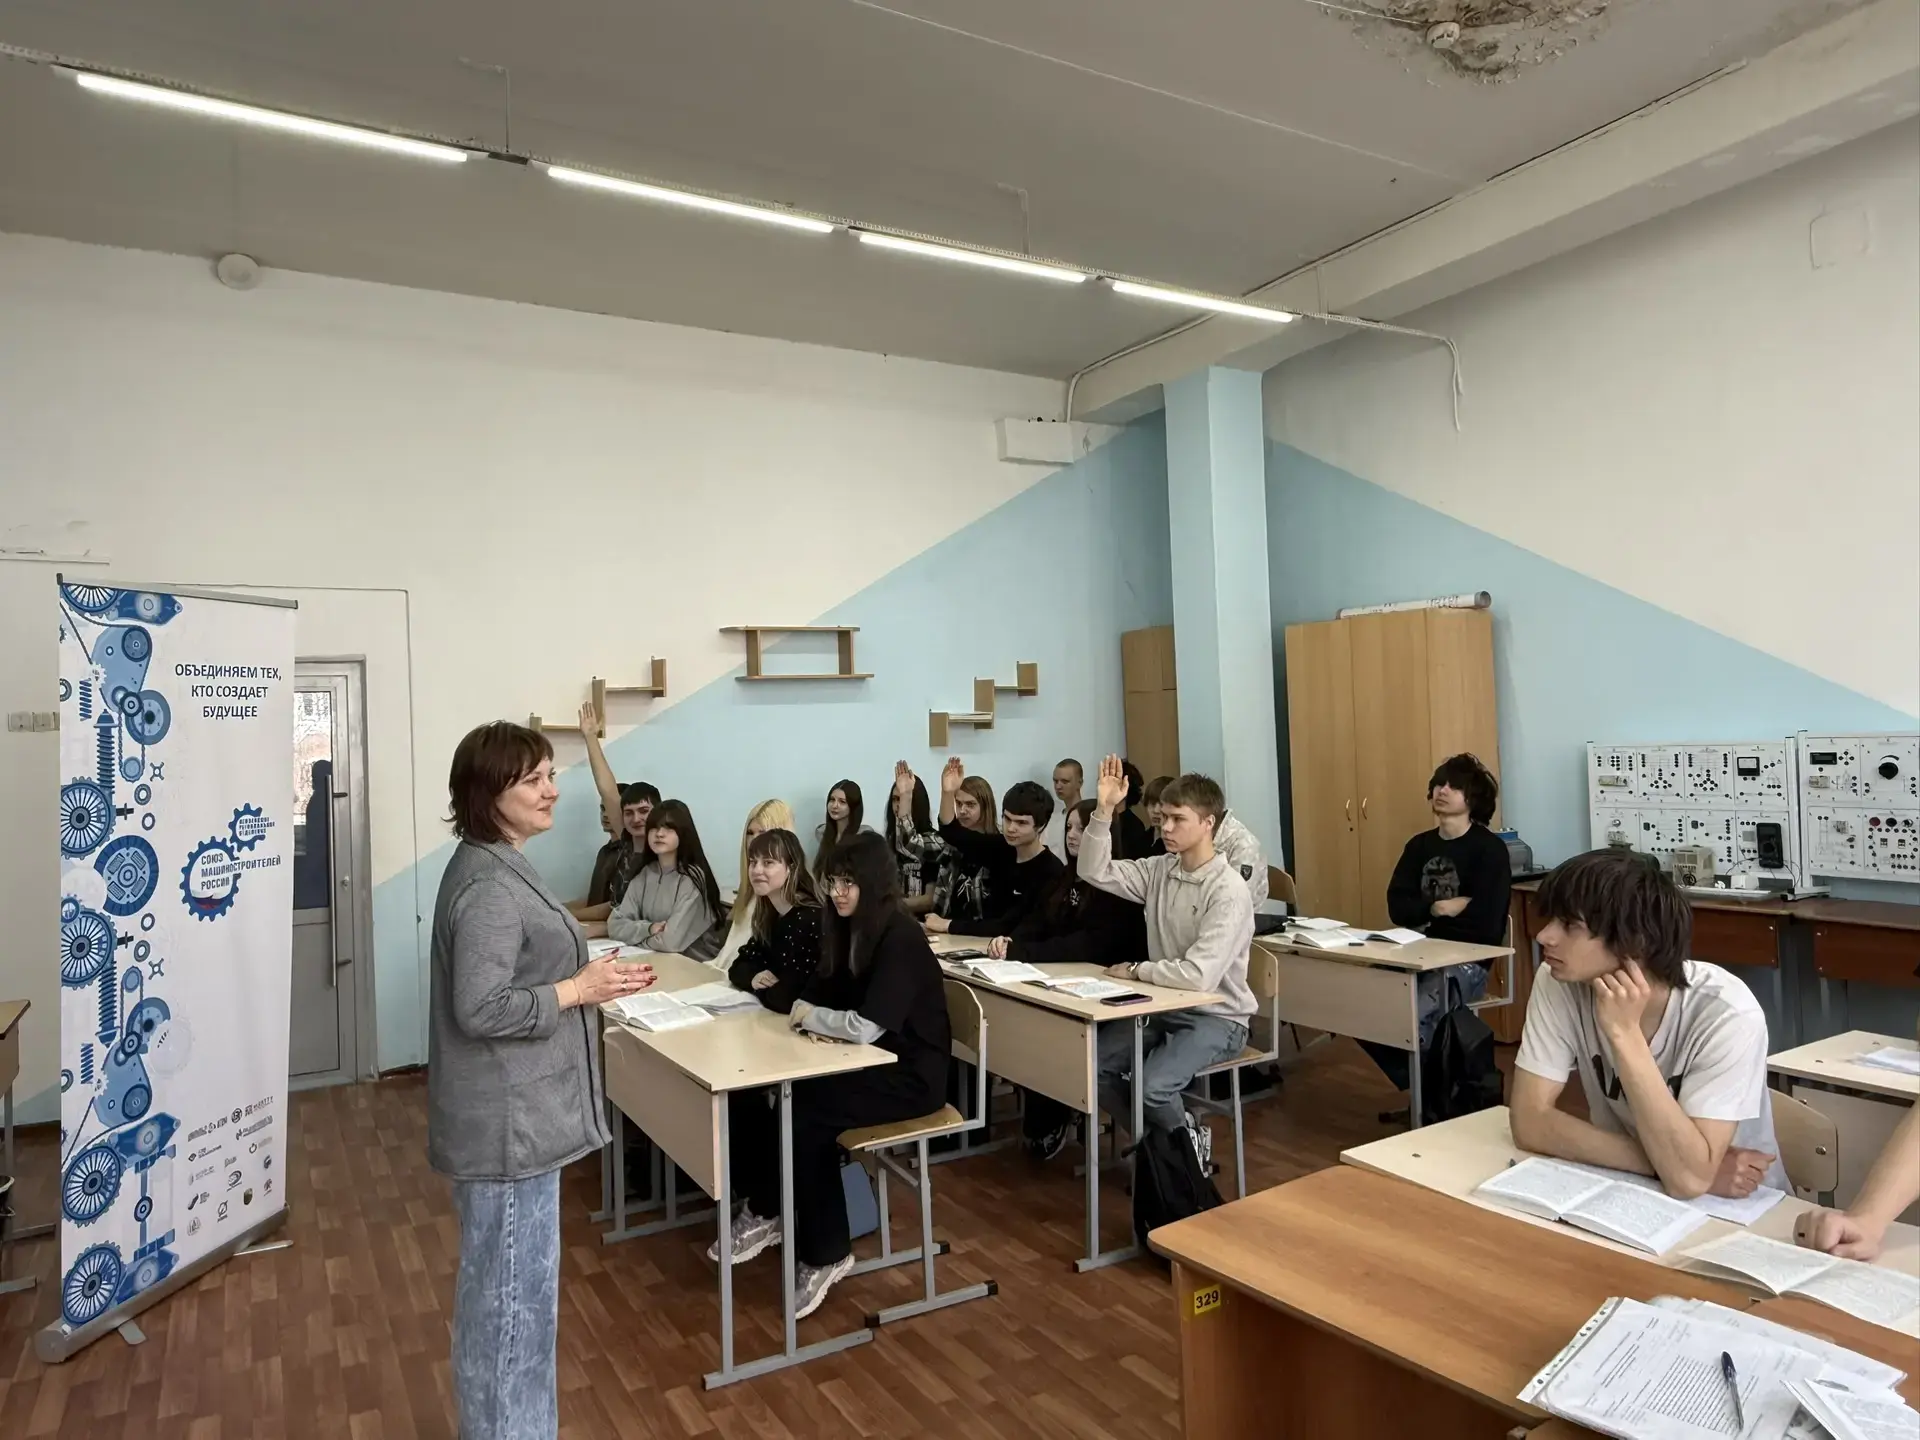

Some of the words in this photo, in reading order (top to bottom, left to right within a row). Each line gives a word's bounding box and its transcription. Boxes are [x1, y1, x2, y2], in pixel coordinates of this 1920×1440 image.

[175, 664, 257, 680] ОБЪЕДИНЯЕМ
[260, 667, 281, 681] ТЕХ,
[192, 685, 213, 698] КТО
[216, 686, 268, 700] СОЗДАЕТ
[203, 706, 257, 720] БУДУЩЕЕ
[201, 853, 224, 865] СОЮЗ
[201, 855, 281, 877] МАШИНОСТРОИТЕЛЕЙ
[201, 877, 230, 890] РОССИИ
[1196, 1290, 1219, 1309] 329
